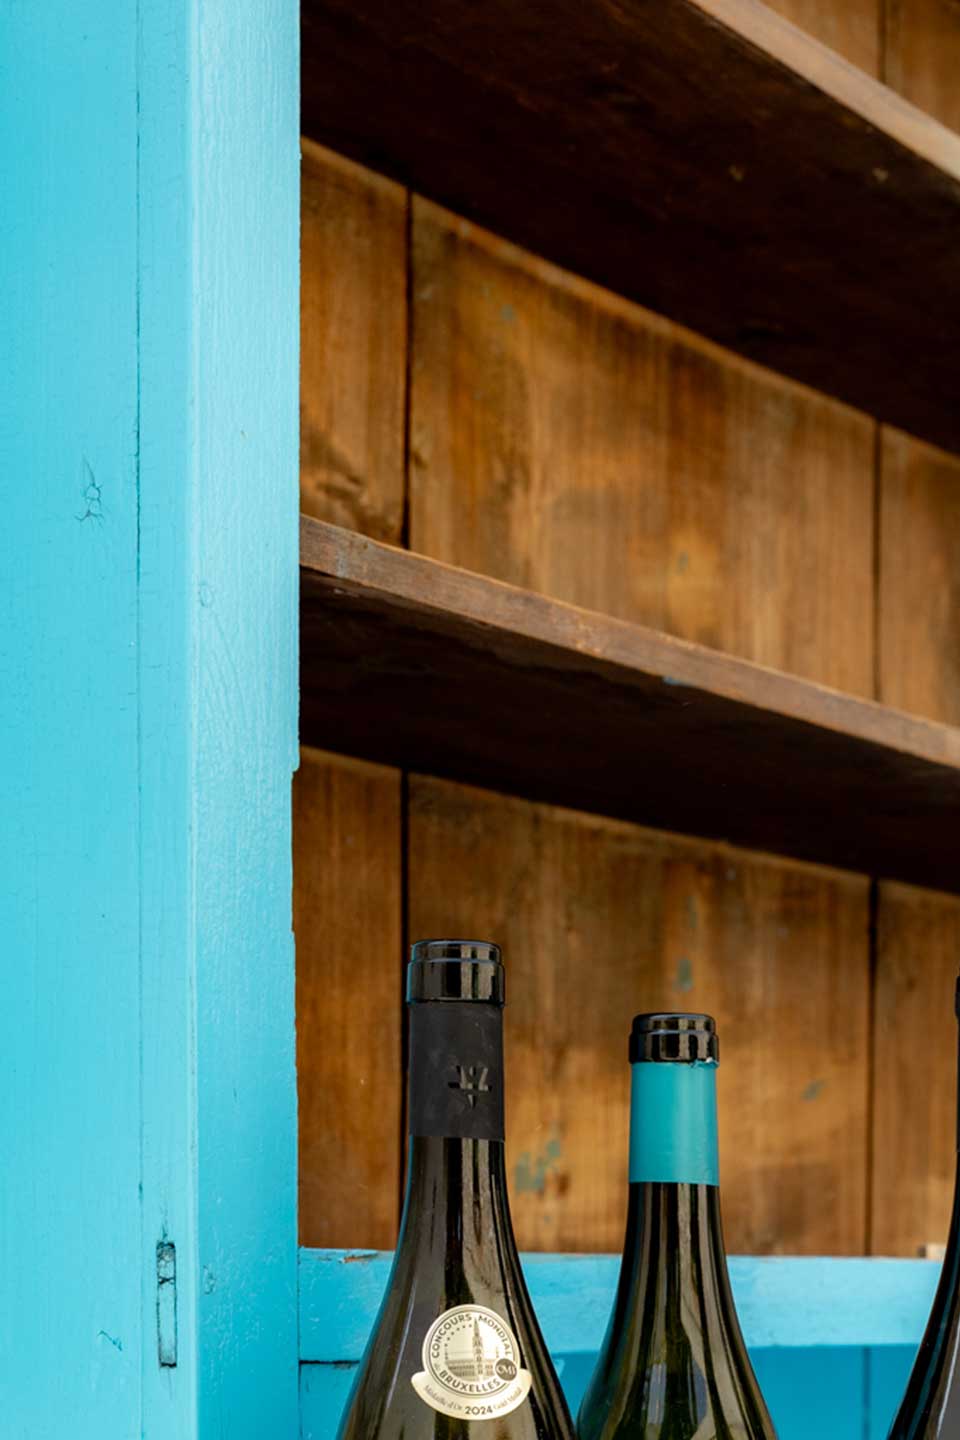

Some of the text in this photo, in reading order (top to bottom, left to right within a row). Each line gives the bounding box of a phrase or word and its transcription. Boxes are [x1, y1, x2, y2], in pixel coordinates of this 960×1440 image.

[431, 1313, 512, 1359] CONCOURS MONDIAL
[439, 1370, 500, 1392] BRUXELLES
[465, 1406, 493, 1415] 2024
